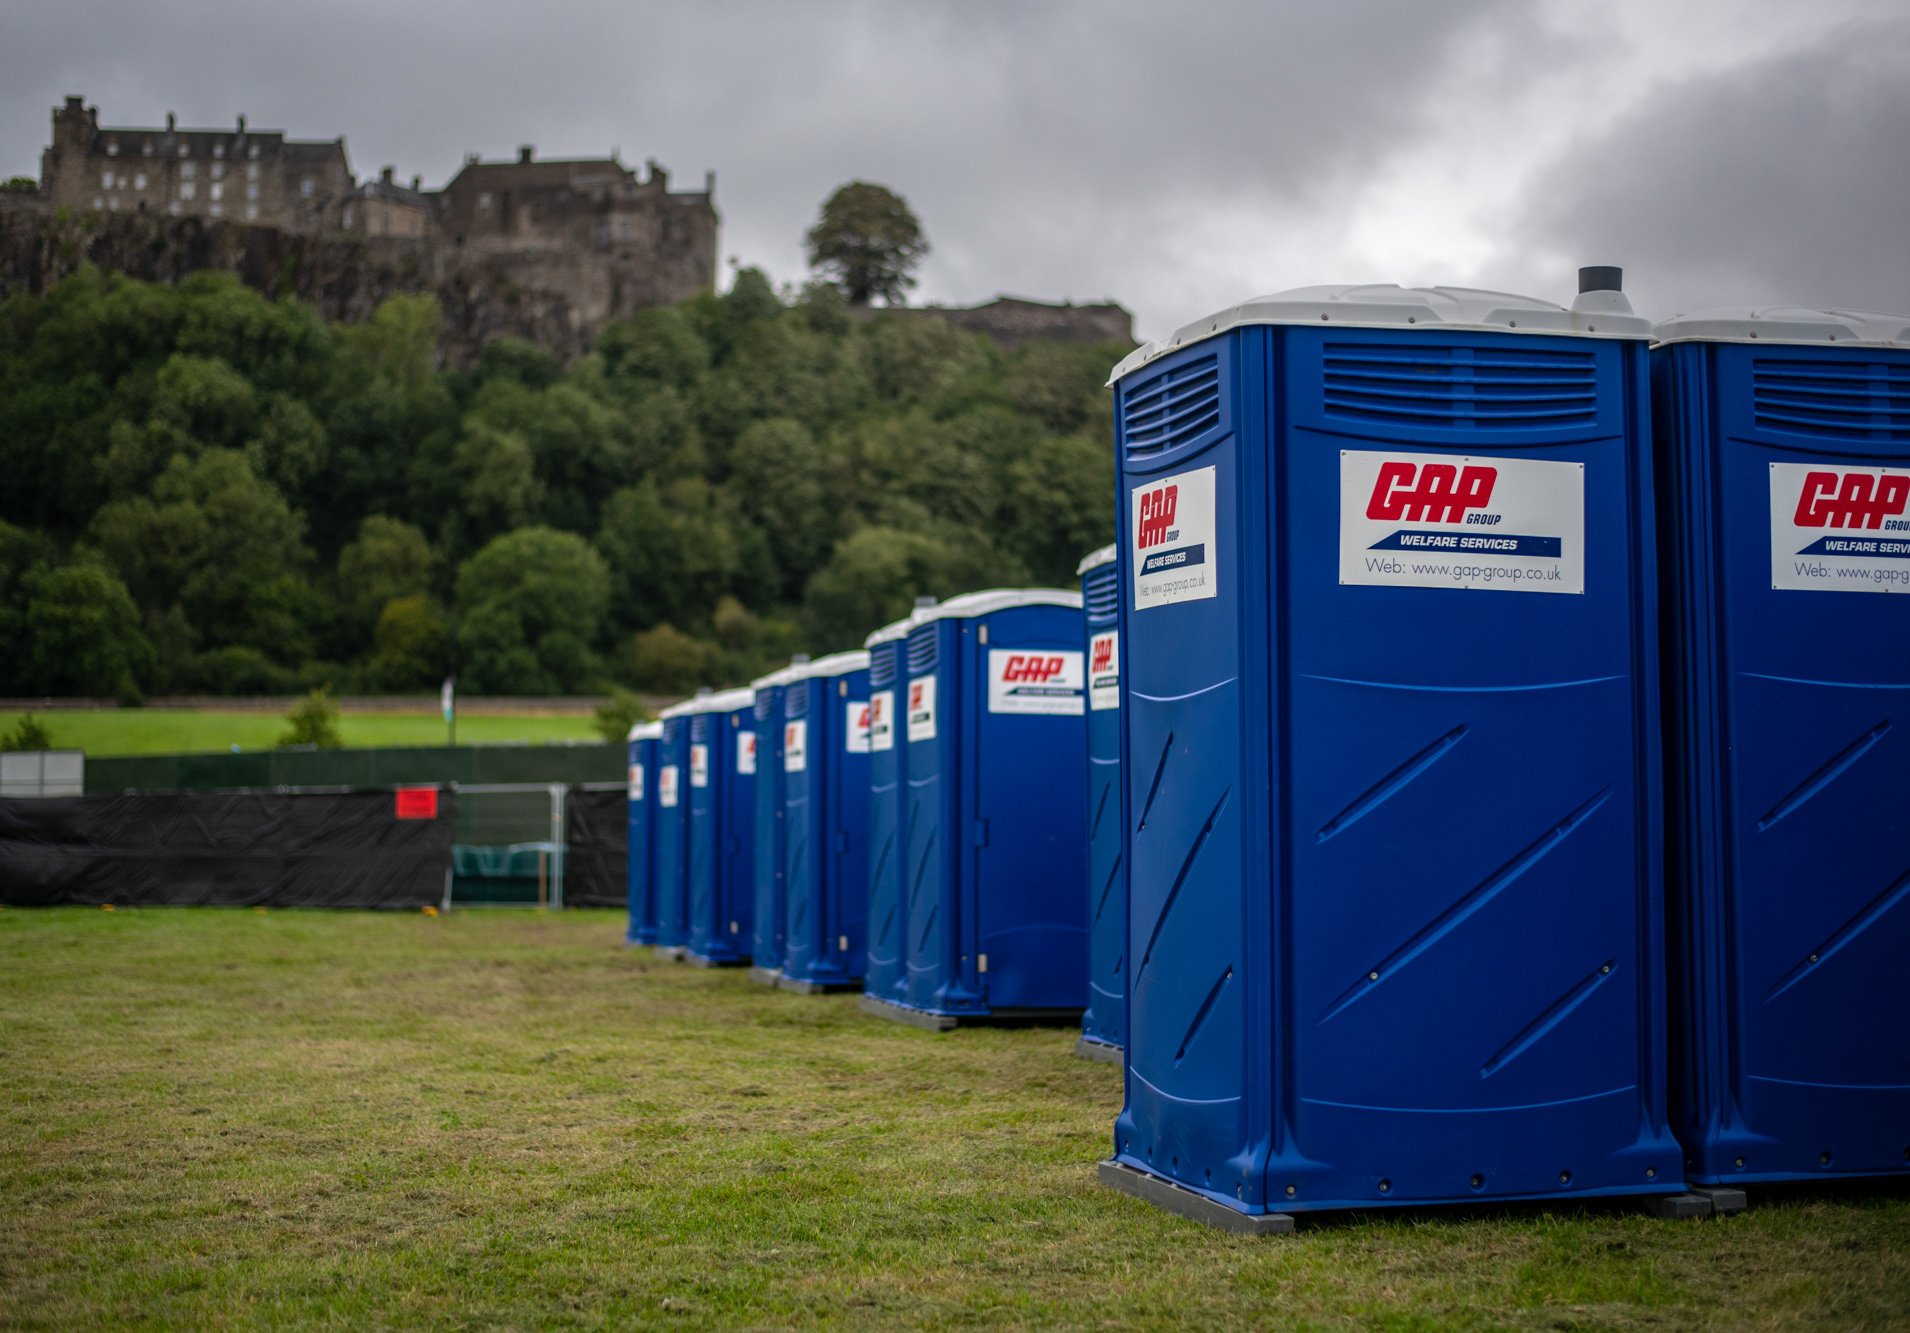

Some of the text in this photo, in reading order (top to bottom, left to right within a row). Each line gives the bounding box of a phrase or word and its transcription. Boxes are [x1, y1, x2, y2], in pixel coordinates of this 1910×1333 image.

[1366, 461, 1498, 524] GAP
[1793, 471, 1910, 530] GAP
[1138, 484, 1178, 550] GAP
[1466, 513, 1502, 526] GROUP
[1884, 519, 1910, 531] GROU
[1400, 534, 1518, 551] WELFARE SERVICES
[1825, 540, 1910, 554] WELFARE SERVI
[1365, 557, 1562, 583] Web: www.gap-group.co.uk
[1794, 561, 1831, 578] Web:
[1001, 655, 1064, 682] GAP
